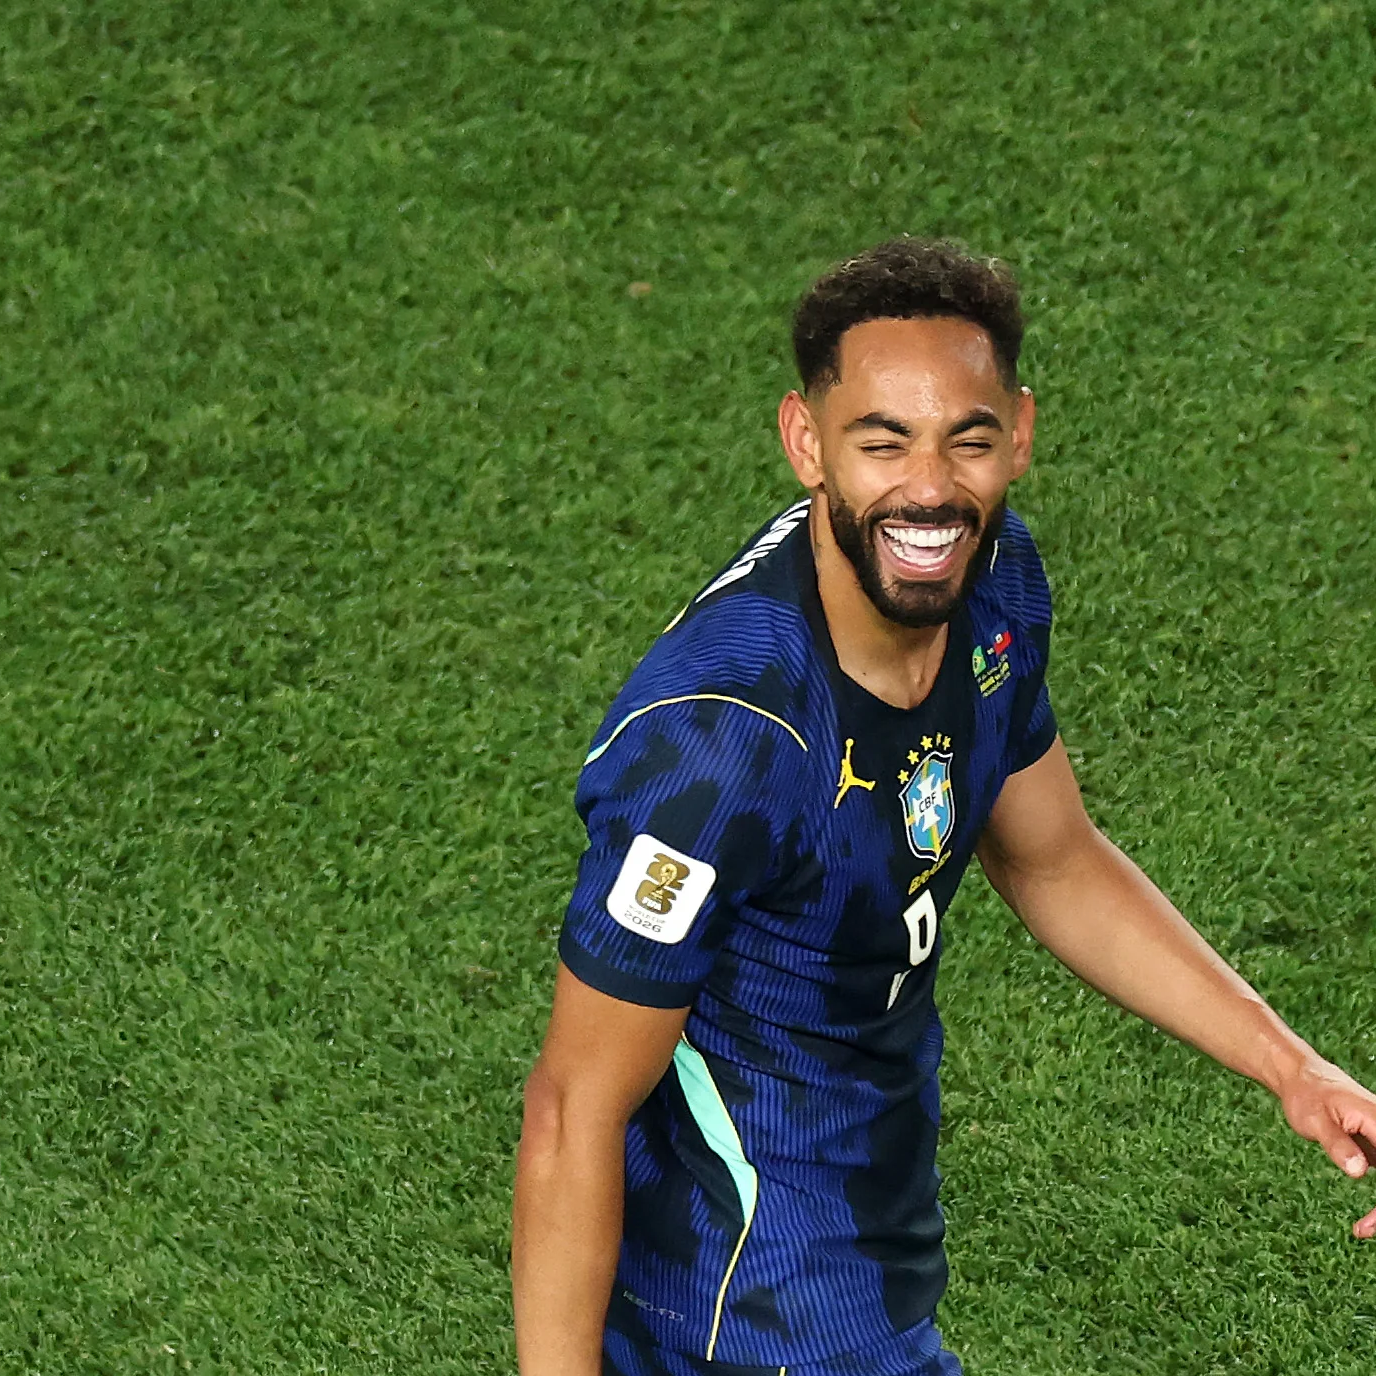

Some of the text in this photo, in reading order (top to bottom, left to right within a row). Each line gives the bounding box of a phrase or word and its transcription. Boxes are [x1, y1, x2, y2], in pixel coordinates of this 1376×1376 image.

[918, 791, 938, 813] CBF
[641, 896, 663, 911] FIFA
[624, 910, 663, 934] 2026
